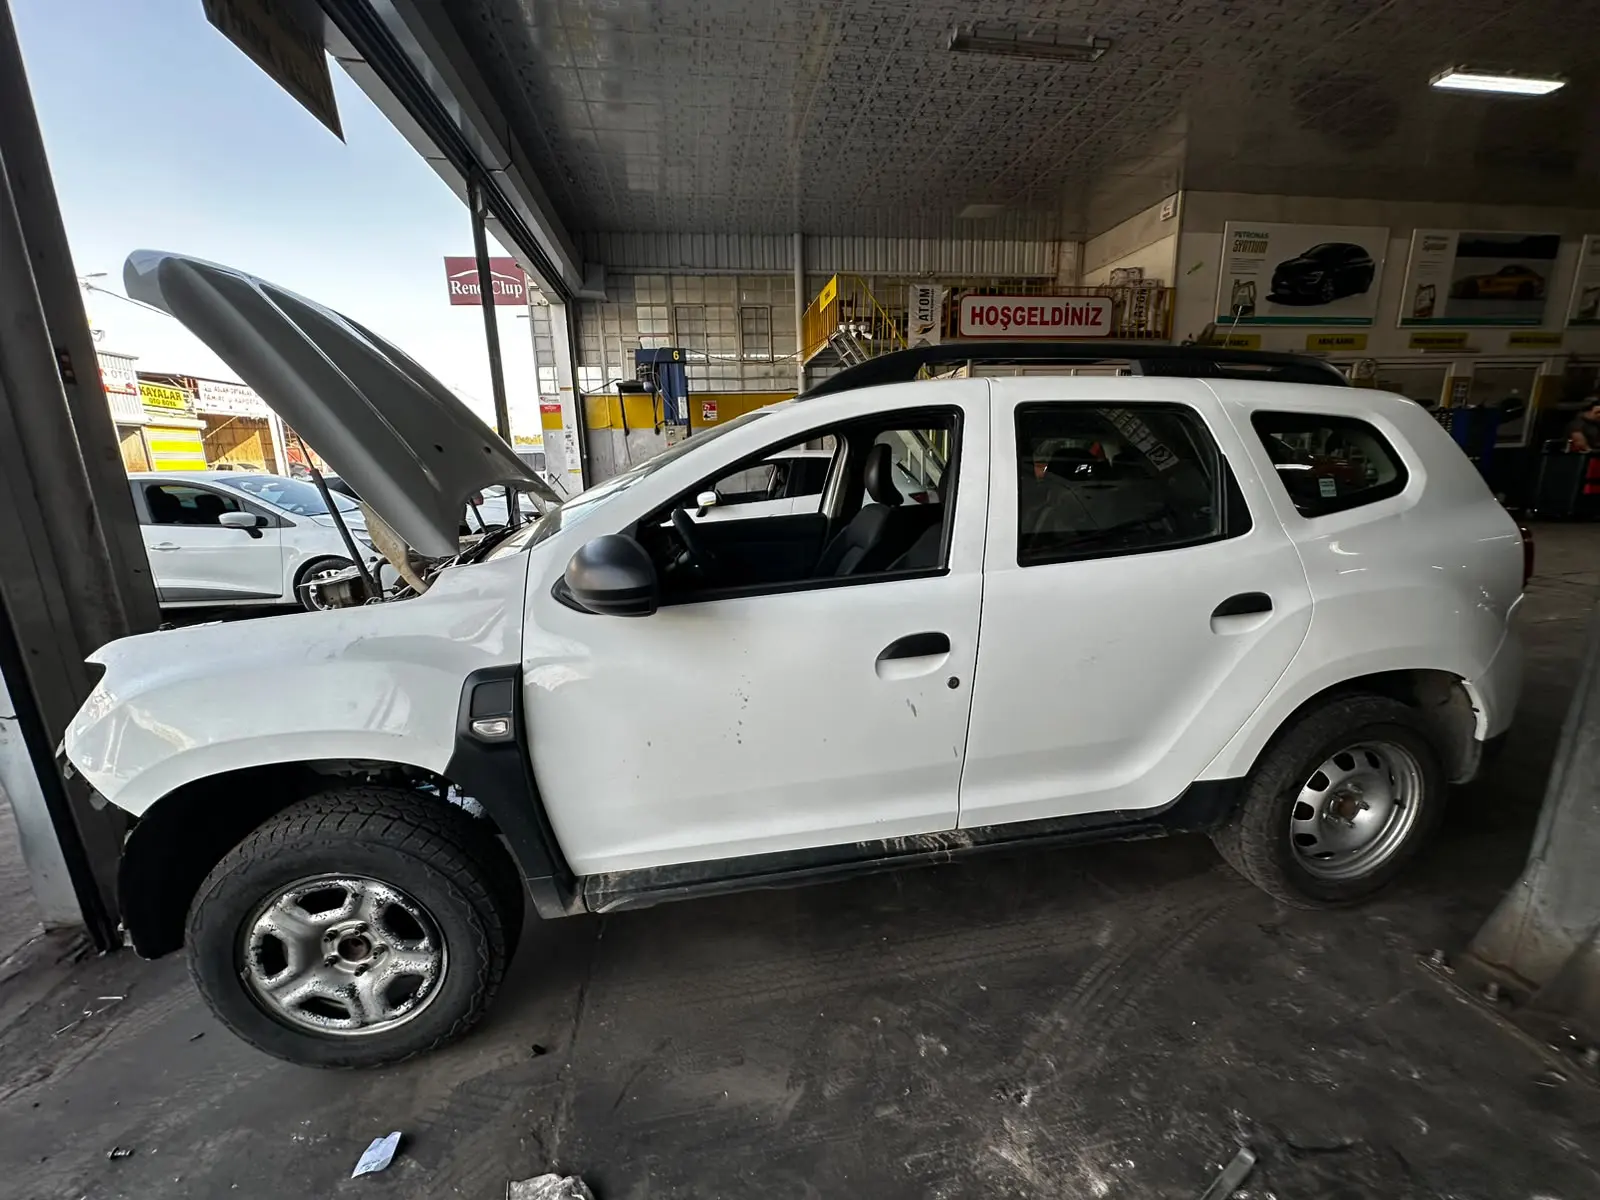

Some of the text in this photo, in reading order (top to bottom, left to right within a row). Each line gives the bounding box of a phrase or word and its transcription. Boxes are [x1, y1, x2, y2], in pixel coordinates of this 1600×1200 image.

[491, 280, 523, 298] Clup
[918, 288, 930, 321] ATOM
[970, 302, 1103, 331] HOŞGELDİNİZ
[672, 350, 680, 361] 6
[139, 385, 182, 401] KAYALAR
